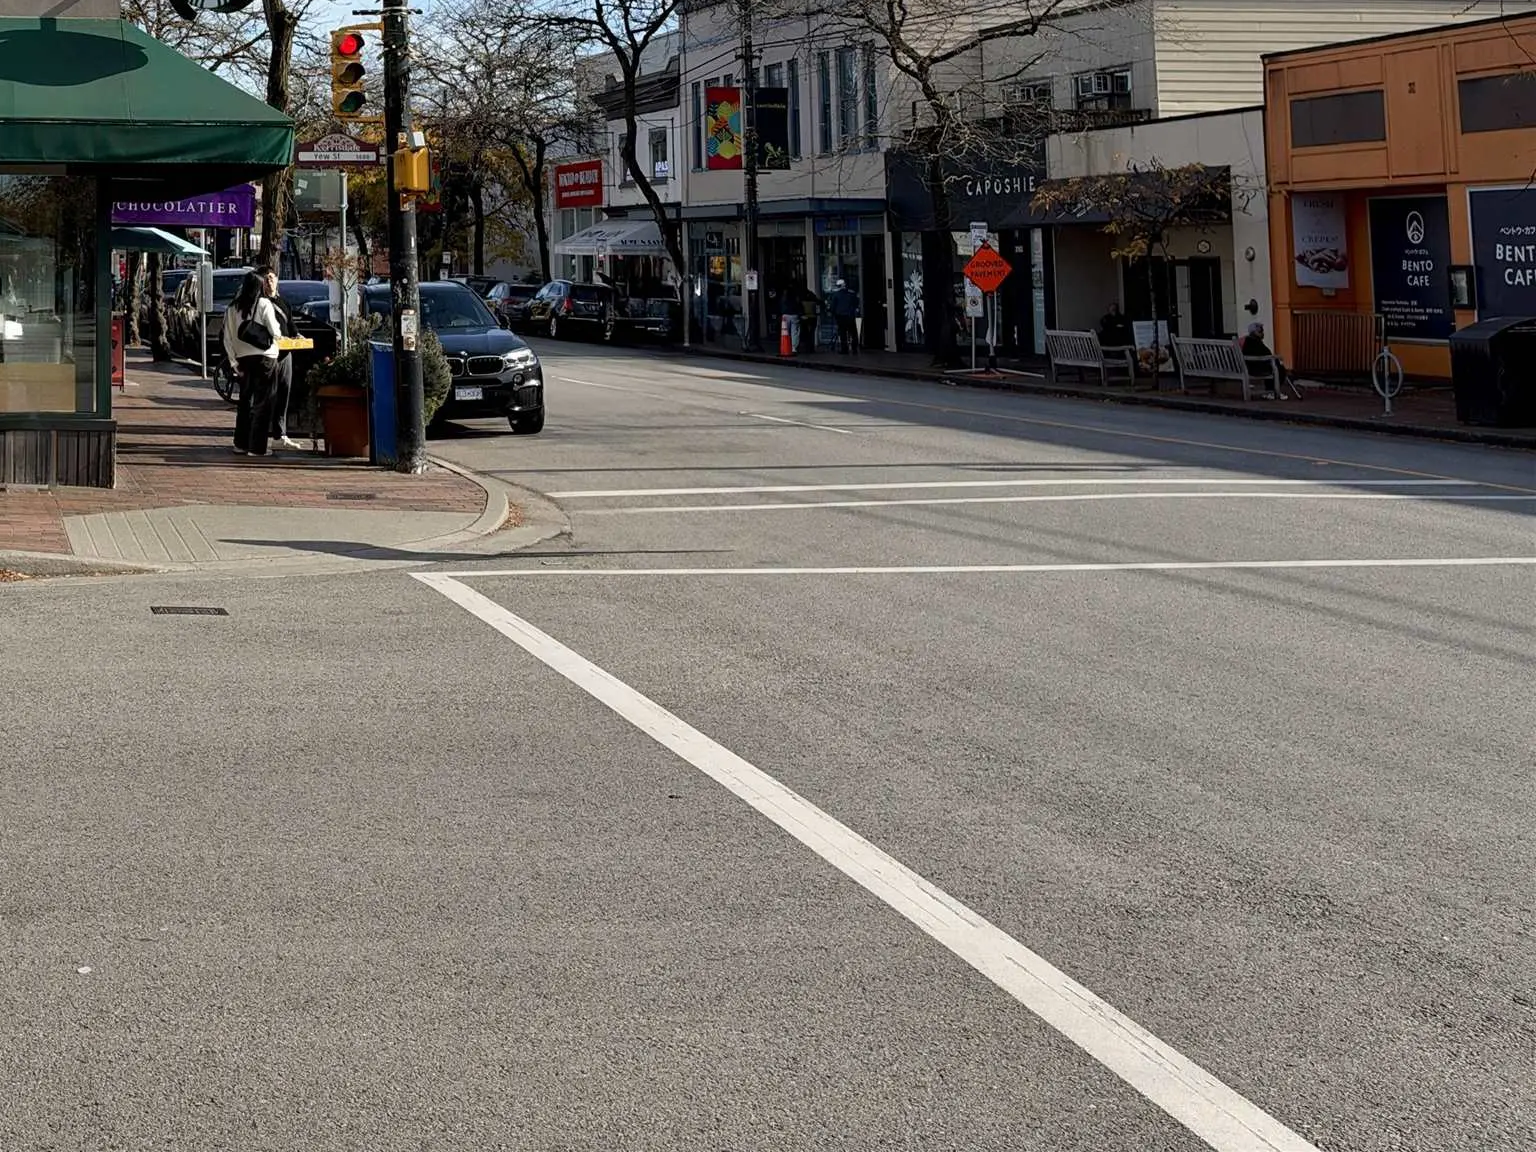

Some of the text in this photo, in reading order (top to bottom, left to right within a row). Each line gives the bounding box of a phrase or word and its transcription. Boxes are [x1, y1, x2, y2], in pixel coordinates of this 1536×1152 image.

[966, 176, 1036, 196] CAPOSHIE
[116, 201, 238, 214] CHOCOLATIER
[1499, 226, 1536, 236] ベントウ・カフ
[1495, 243, 1536, 262] BENT
[1402, 259, 1433, 272] BENTO
[1407, 274, 1431, 287] CAFE
[1504, 268, 1536, 286] CAF
